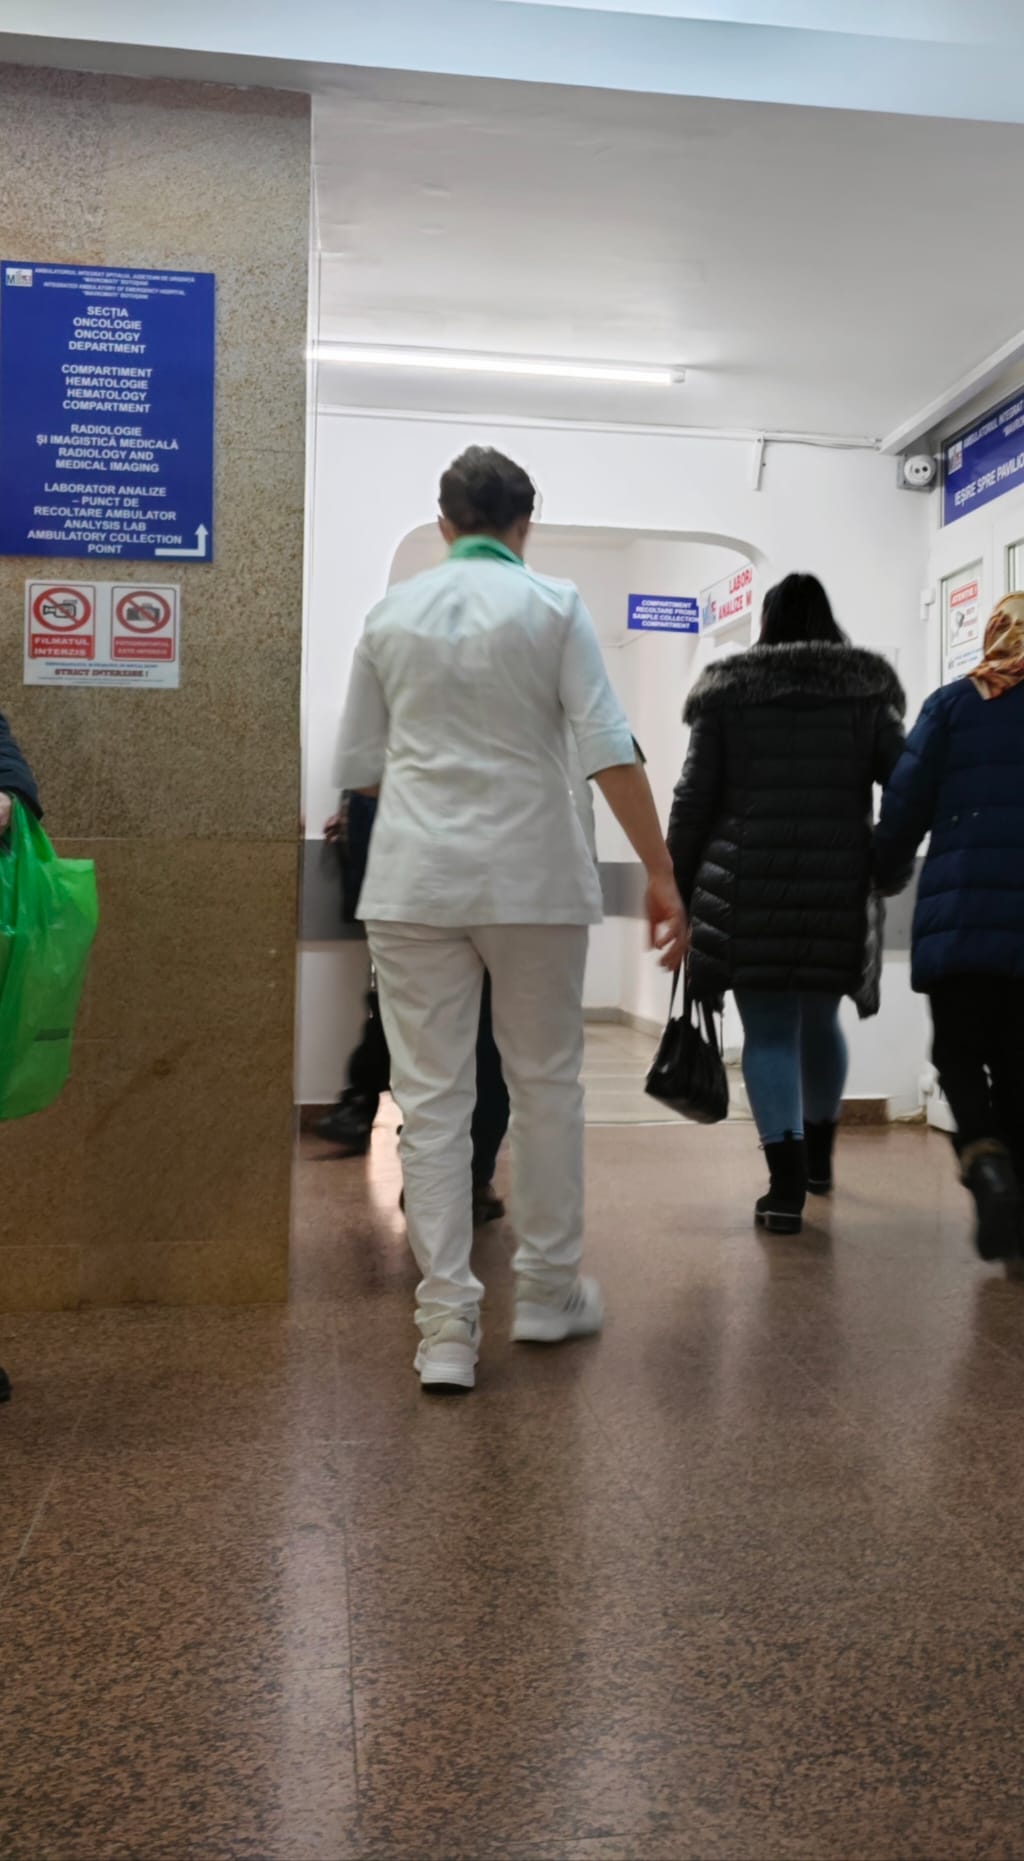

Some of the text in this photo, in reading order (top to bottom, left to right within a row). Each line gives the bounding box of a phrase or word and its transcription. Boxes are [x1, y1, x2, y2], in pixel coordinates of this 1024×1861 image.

[87, 306, 129, 319] SECȚIA
[73, 317, 142, 330] ONCOLOGIE
[74, 329, 140, 342] ONCOLOGY
[68, 341, 146, 354] DEPARTMENT
[61, 364, 153, 378] COMPARTIMENT
[65, 376, 149, 390] HEMATOLOGIE
[66, 388, 147, 402] HEMATOLOGY
[63, 400, 151, 413] COMPARTMENT
[71, 424, 142, 436] RADIOLOGIE
[50, 434, 117, 448] IMAGISTICĂ
[119, 437, 179, 450] MEDICALĂ
[58, 447, 154, 461] RADIOLOGY AND
[55, 459, 160, 473] MEDICAL IMAGING
[977, 469, 996, 494] SPRE
[44, 482, 167, 497] LABORATOR ANALIZE
[82, 496, 139, 508] PUNCT DE
[33, 506, 176, 520] RECOLTARE AMBULATOR
[64, 520, 146, 532] ANALYSIS LAB
[27, 530, 182, 544] AMBULATORY COLLECTION
[88, 544, 123, 554] POINT
